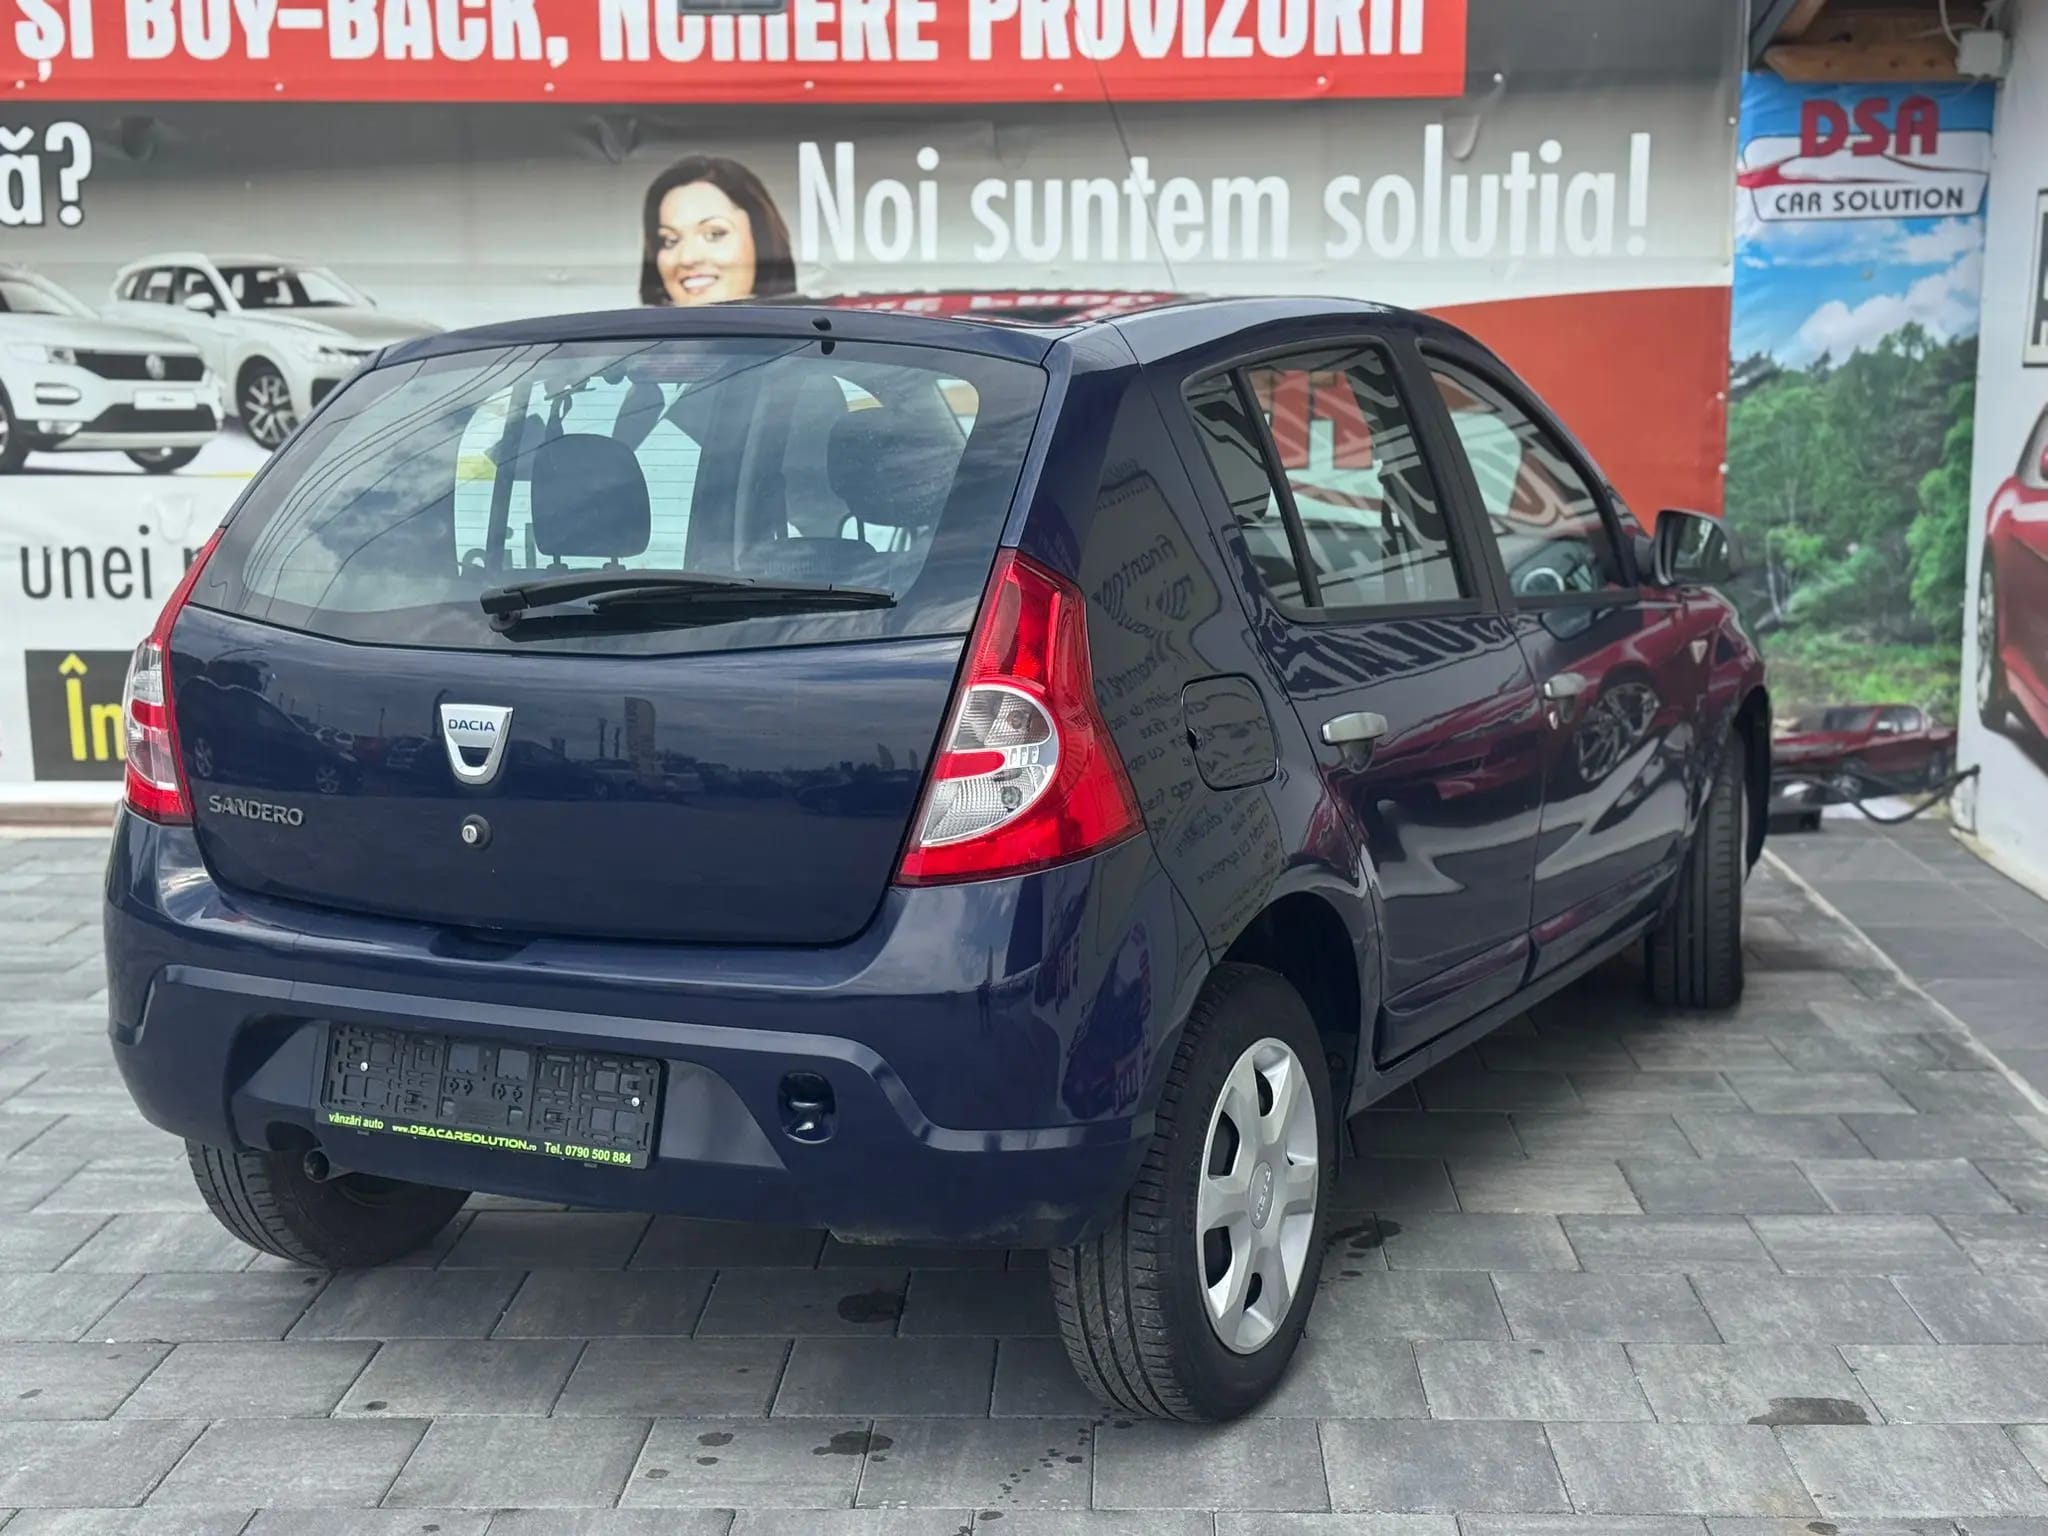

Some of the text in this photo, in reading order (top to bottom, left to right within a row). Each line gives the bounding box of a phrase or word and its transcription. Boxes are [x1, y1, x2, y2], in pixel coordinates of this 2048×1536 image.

[124, 0, 569, 67] BUY-BACK,
[969, 0, 1424, 61] PROVIZORII
[1801, 97, 1938, 158] DSA
[799, 123, 1651, 263] Noi suntem solutia!
[1774, 187, 1965, 214] CAR SOLUTION
[20, 525, 152, 600] unei
[448, 718, 496, 732] DACIA
[208, 795, 304, 827] SANDERO
[363, 1118, 385, 1130] auto
[391, 1124, 538, 1152] www.DSACARSOLUTION.ro
[543, 1141, 563, 1156] Tel.
[565, 1144, 590, 1159] 0790
[591, 1148, 611, 1162] 500
[612, 1151, 632, 1165] 884
